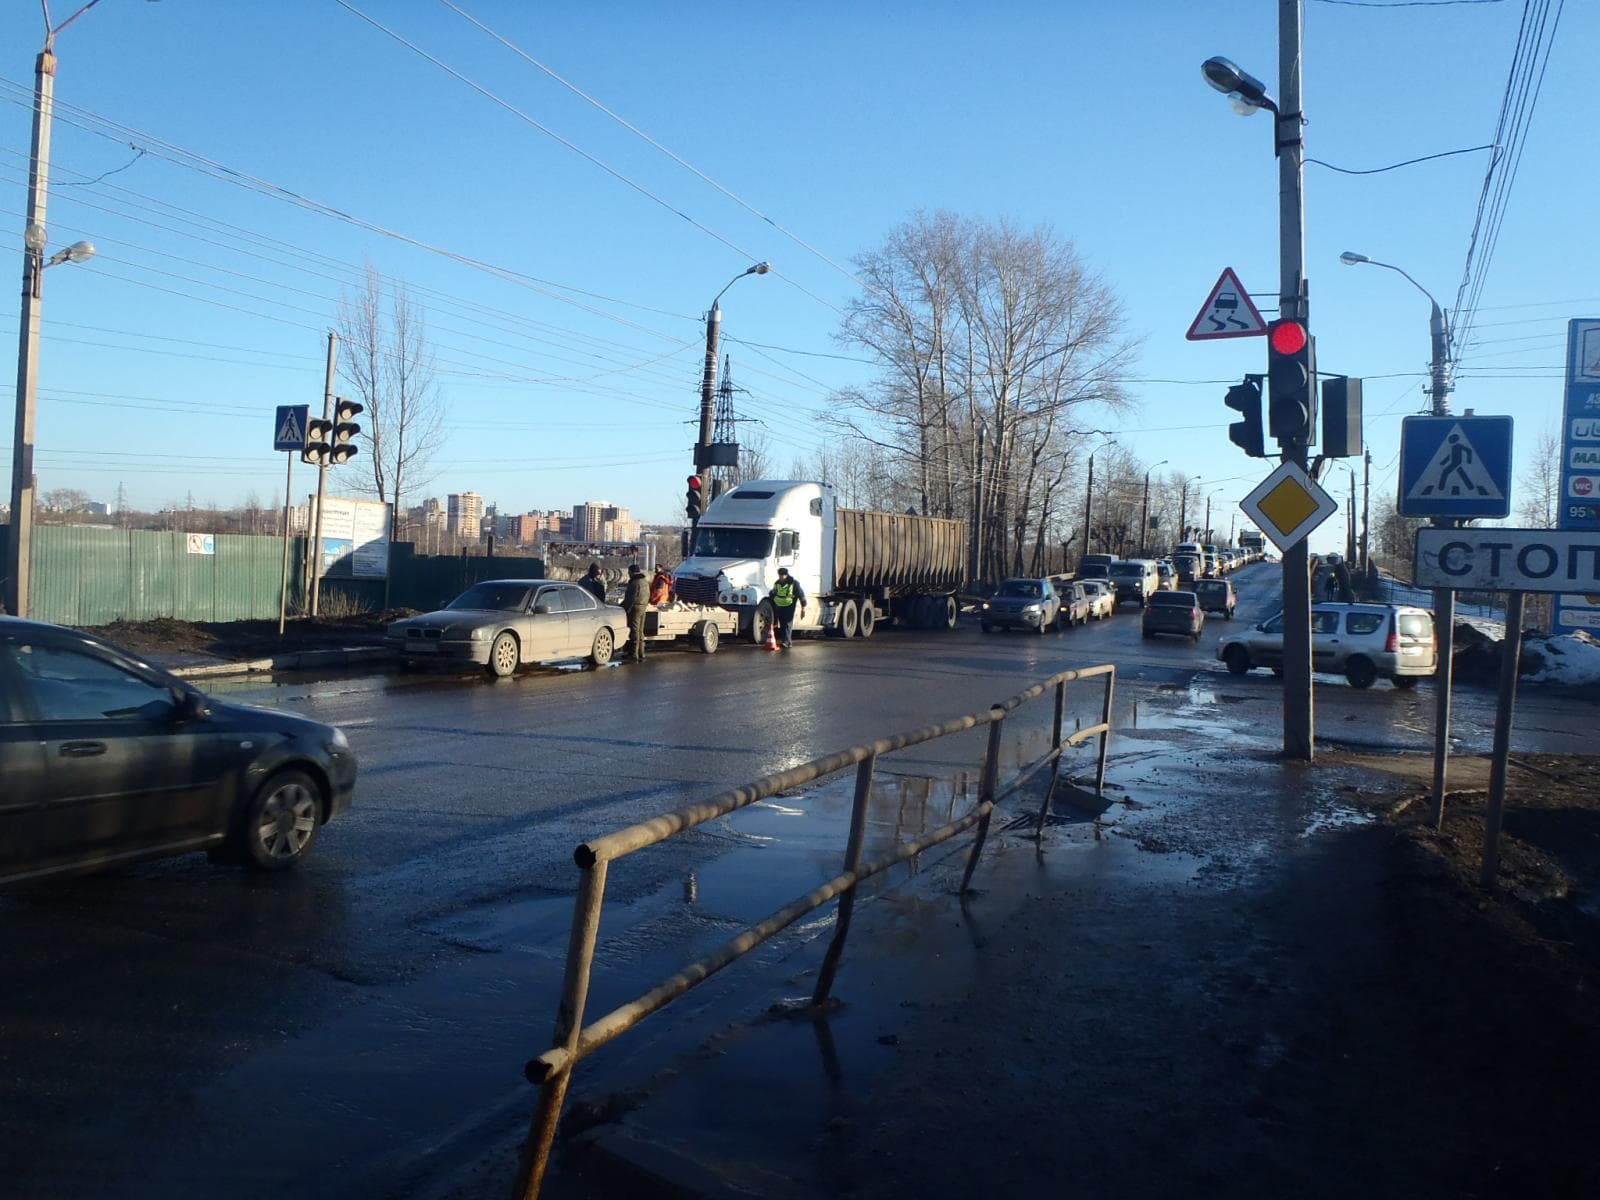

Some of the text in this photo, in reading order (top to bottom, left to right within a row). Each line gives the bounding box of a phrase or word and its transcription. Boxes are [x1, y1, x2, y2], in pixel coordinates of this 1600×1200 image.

[1575, 483, 1591, 491] WC
[1569, 506, 1586, 518] 95
[1438, 541, 1600, 580] СТОП
